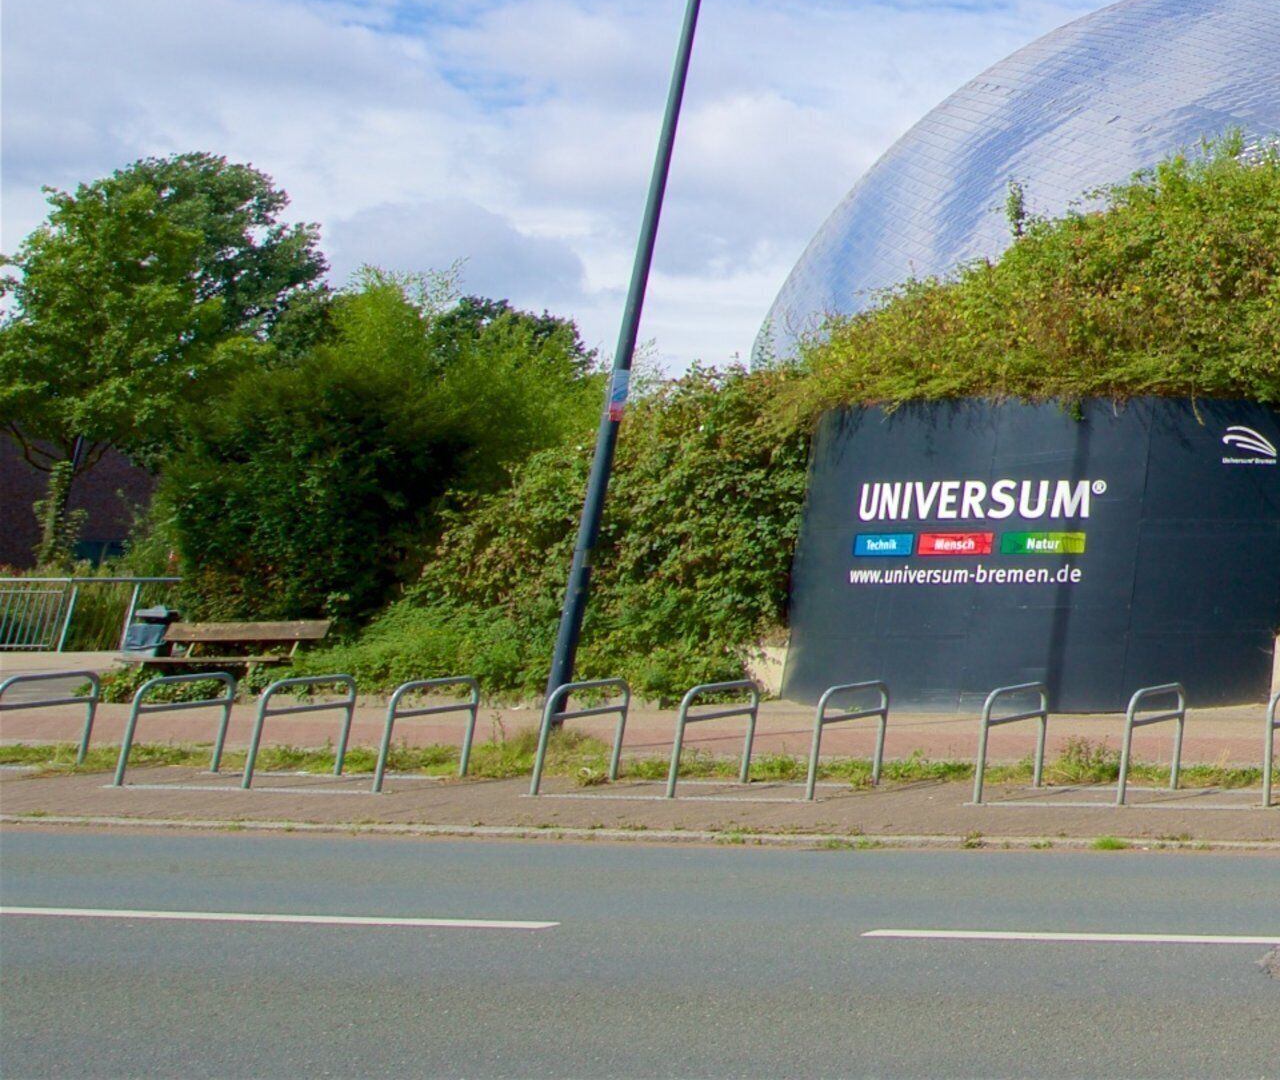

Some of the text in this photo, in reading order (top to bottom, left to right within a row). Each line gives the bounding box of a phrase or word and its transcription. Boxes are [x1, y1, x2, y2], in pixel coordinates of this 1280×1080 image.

[866, 537, 1060, 551] Technik Mensch Natur
[850, 564, 1082, 584] www.universum-bremen.de
